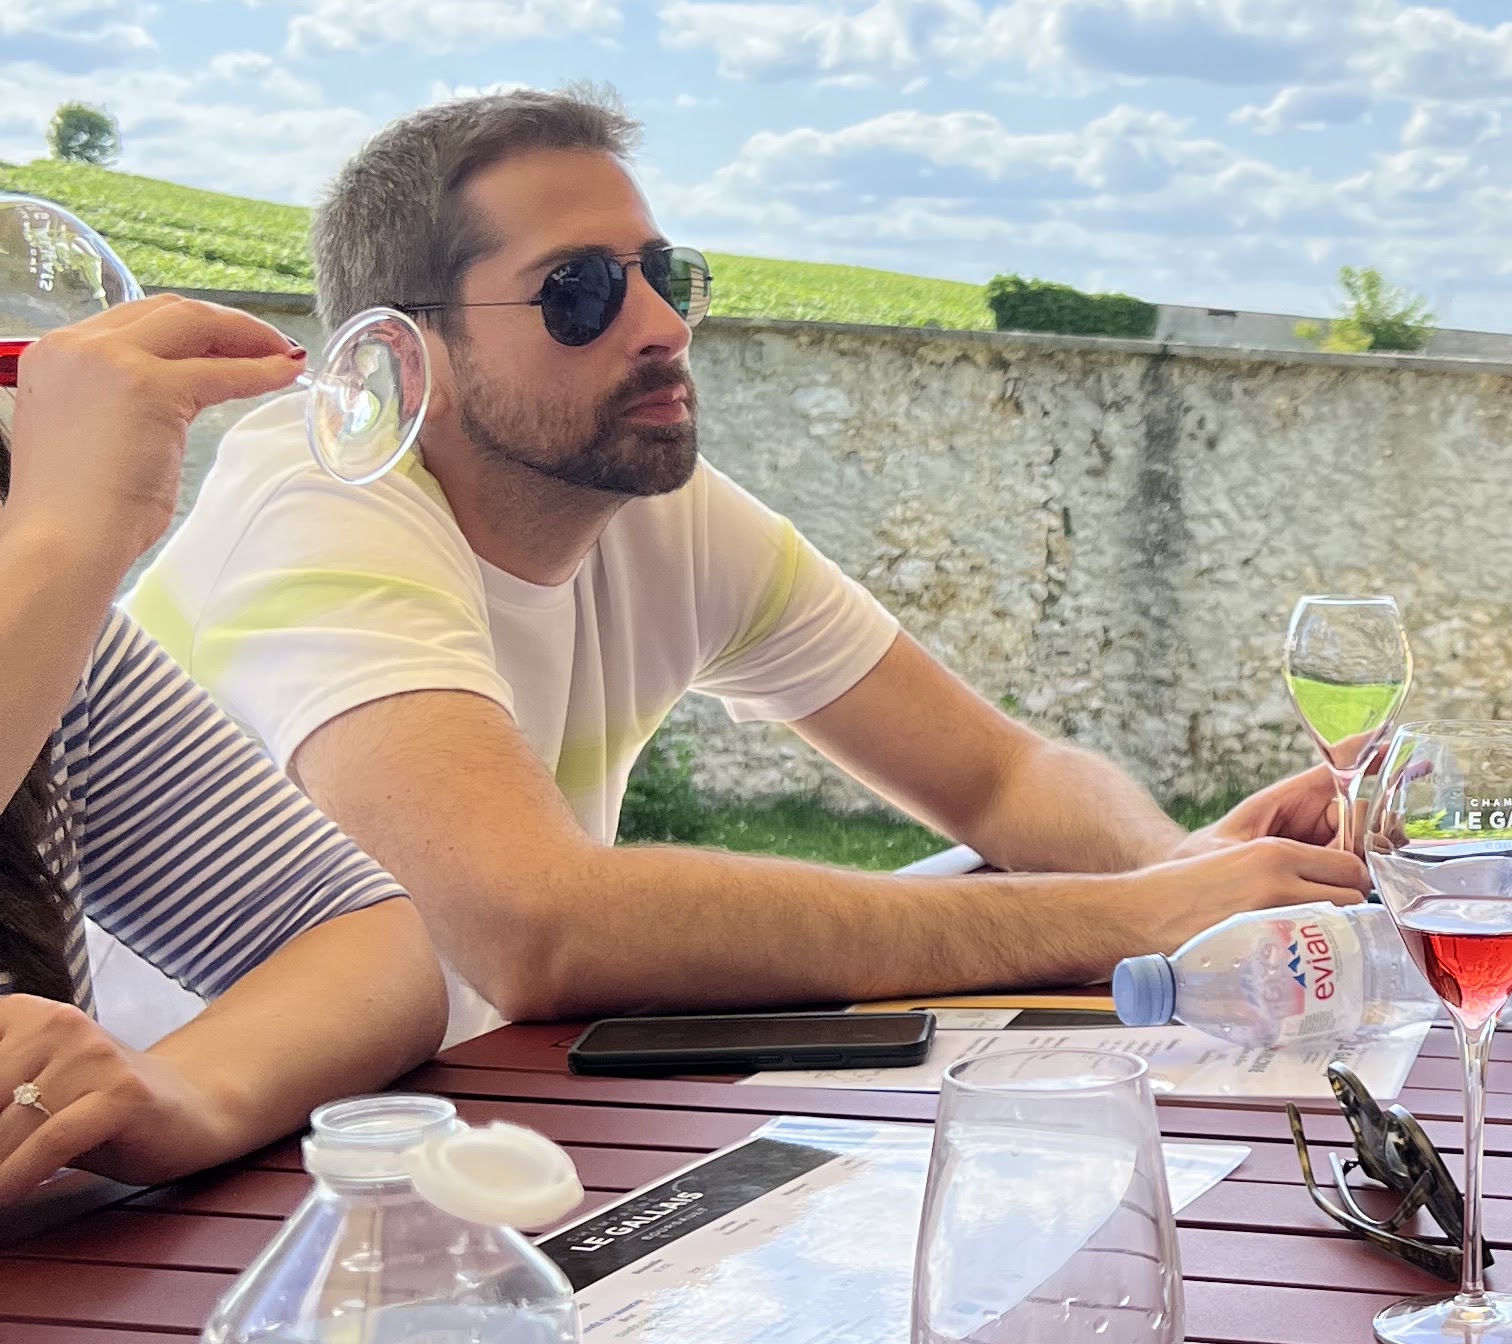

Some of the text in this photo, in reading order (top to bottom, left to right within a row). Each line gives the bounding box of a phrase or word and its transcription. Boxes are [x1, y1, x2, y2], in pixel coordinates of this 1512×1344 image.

[1453, 811, 1483, 830] LE
[1300, 924, 1335, 1001] evian
[569, 1235, 616, 1253] LE
[604, 1191, 704, 1237] GALLAIS
